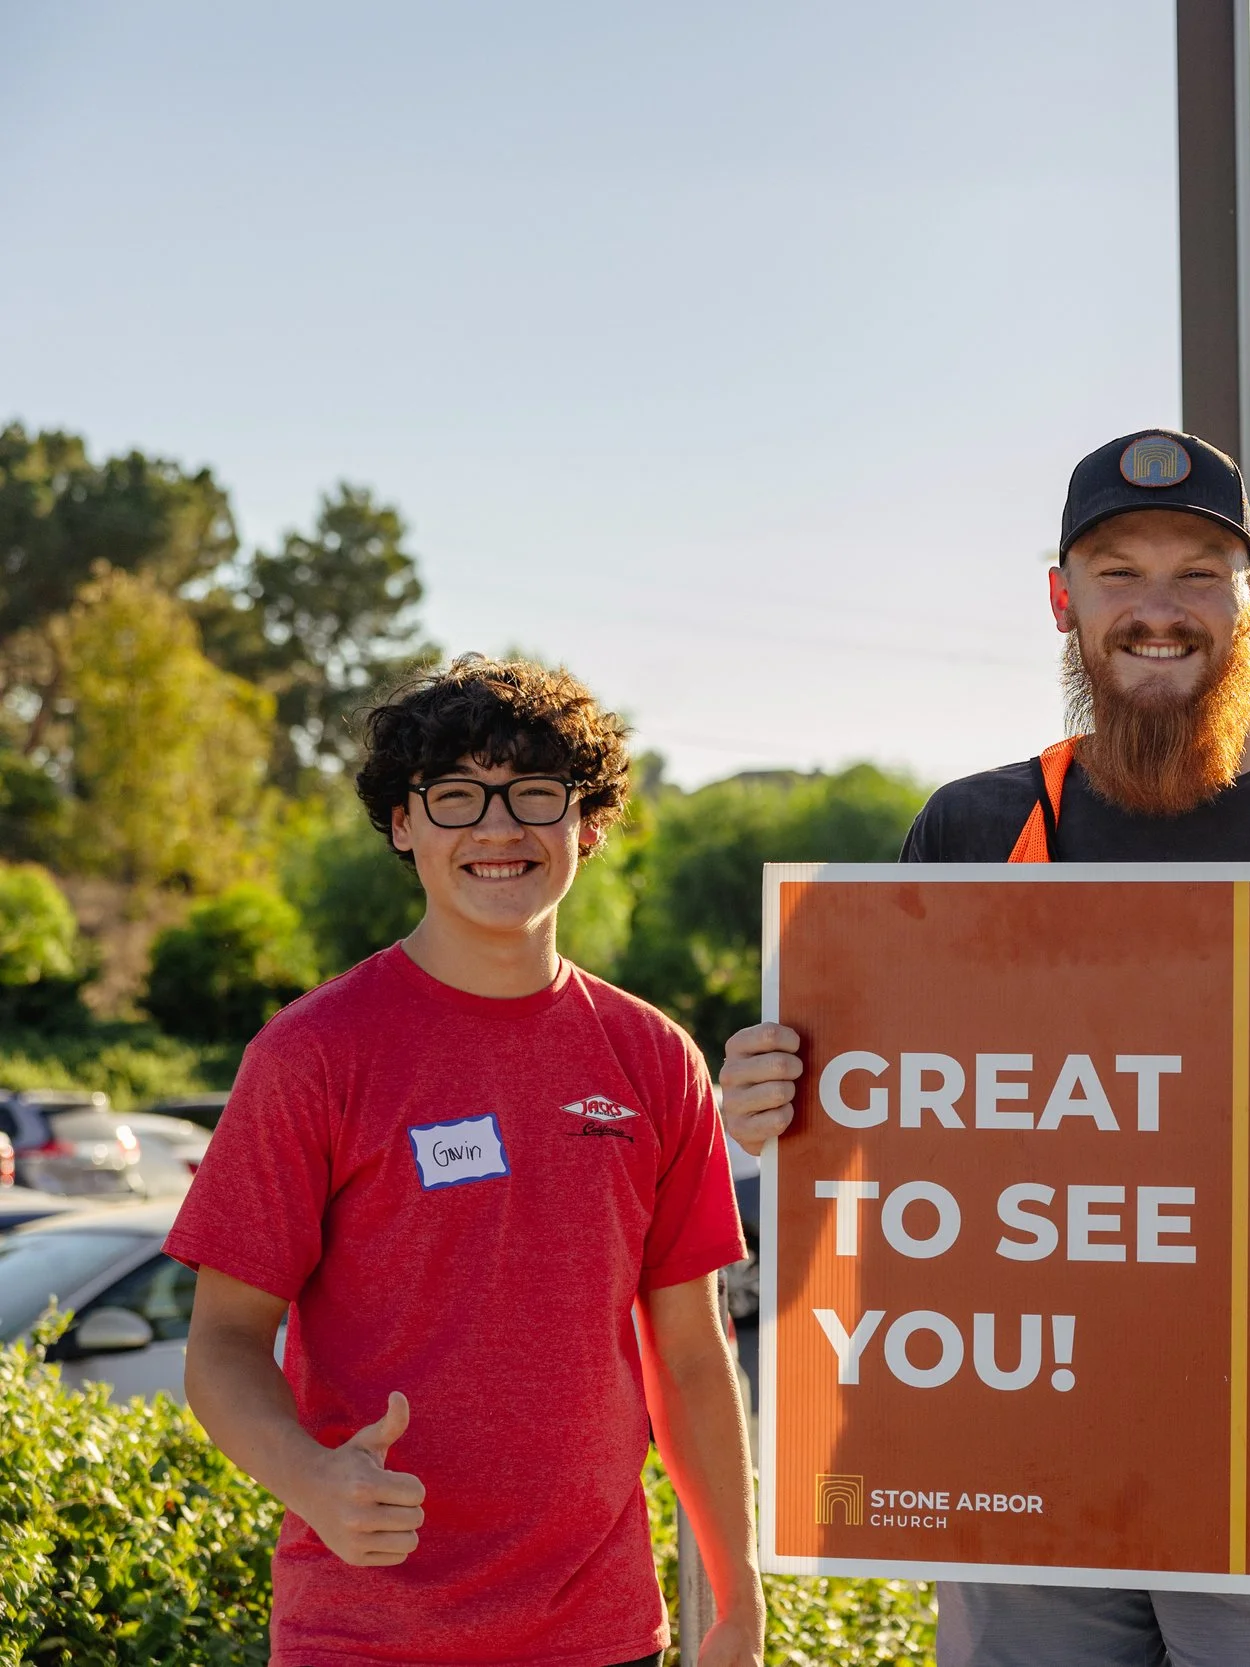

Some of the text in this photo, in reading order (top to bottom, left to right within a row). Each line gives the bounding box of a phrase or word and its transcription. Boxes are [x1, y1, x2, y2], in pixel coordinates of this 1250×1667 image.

[819, 1050, 1182, 1132] GREAT
[581, 1100, 622, 1116] JACKS
[432, 1140, 482, 1167] Gavin
[815, 1180, 1197, 1264] TO SEE
[812, 1308, 1076, 1392] YOU!
[870, 1489, 1044, 1514] STONE ARBOR
[870, 1514, 948, 1529] CHURCH
